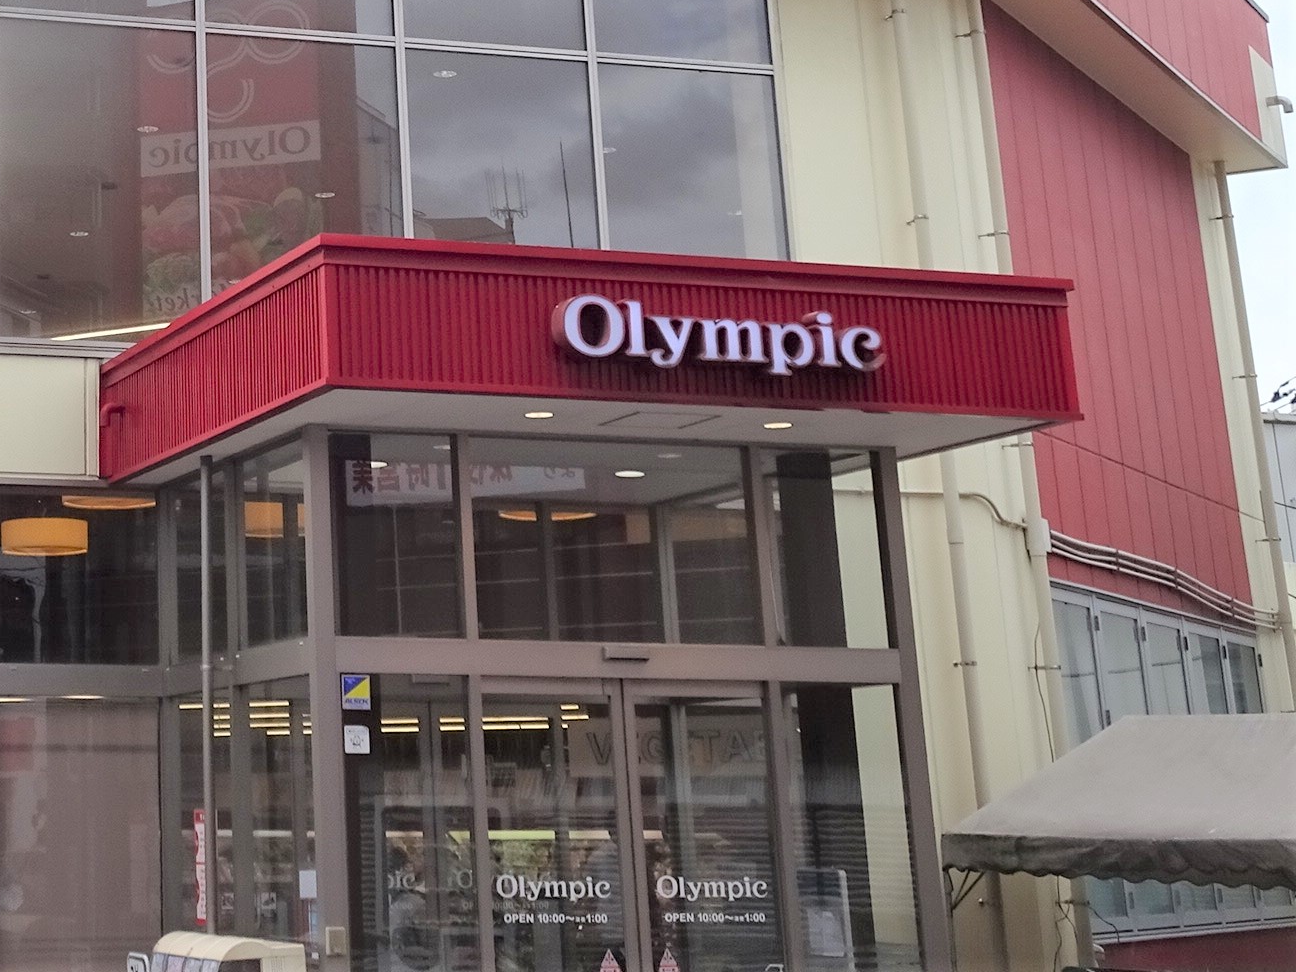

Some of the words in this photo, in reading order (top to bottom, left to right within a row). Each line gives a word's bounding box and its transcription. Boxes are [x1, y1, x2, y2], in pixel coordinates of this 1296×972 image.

[552, 294, 886, 376] Olympic
[586, 729, 764, 766] VGTA
[495, 874, 612, 903] Olympic
[655, 875, 768, 902] Olympic
[504, 913, 535, 925] OPEN
[664, 912, 694, 924] OPEN
